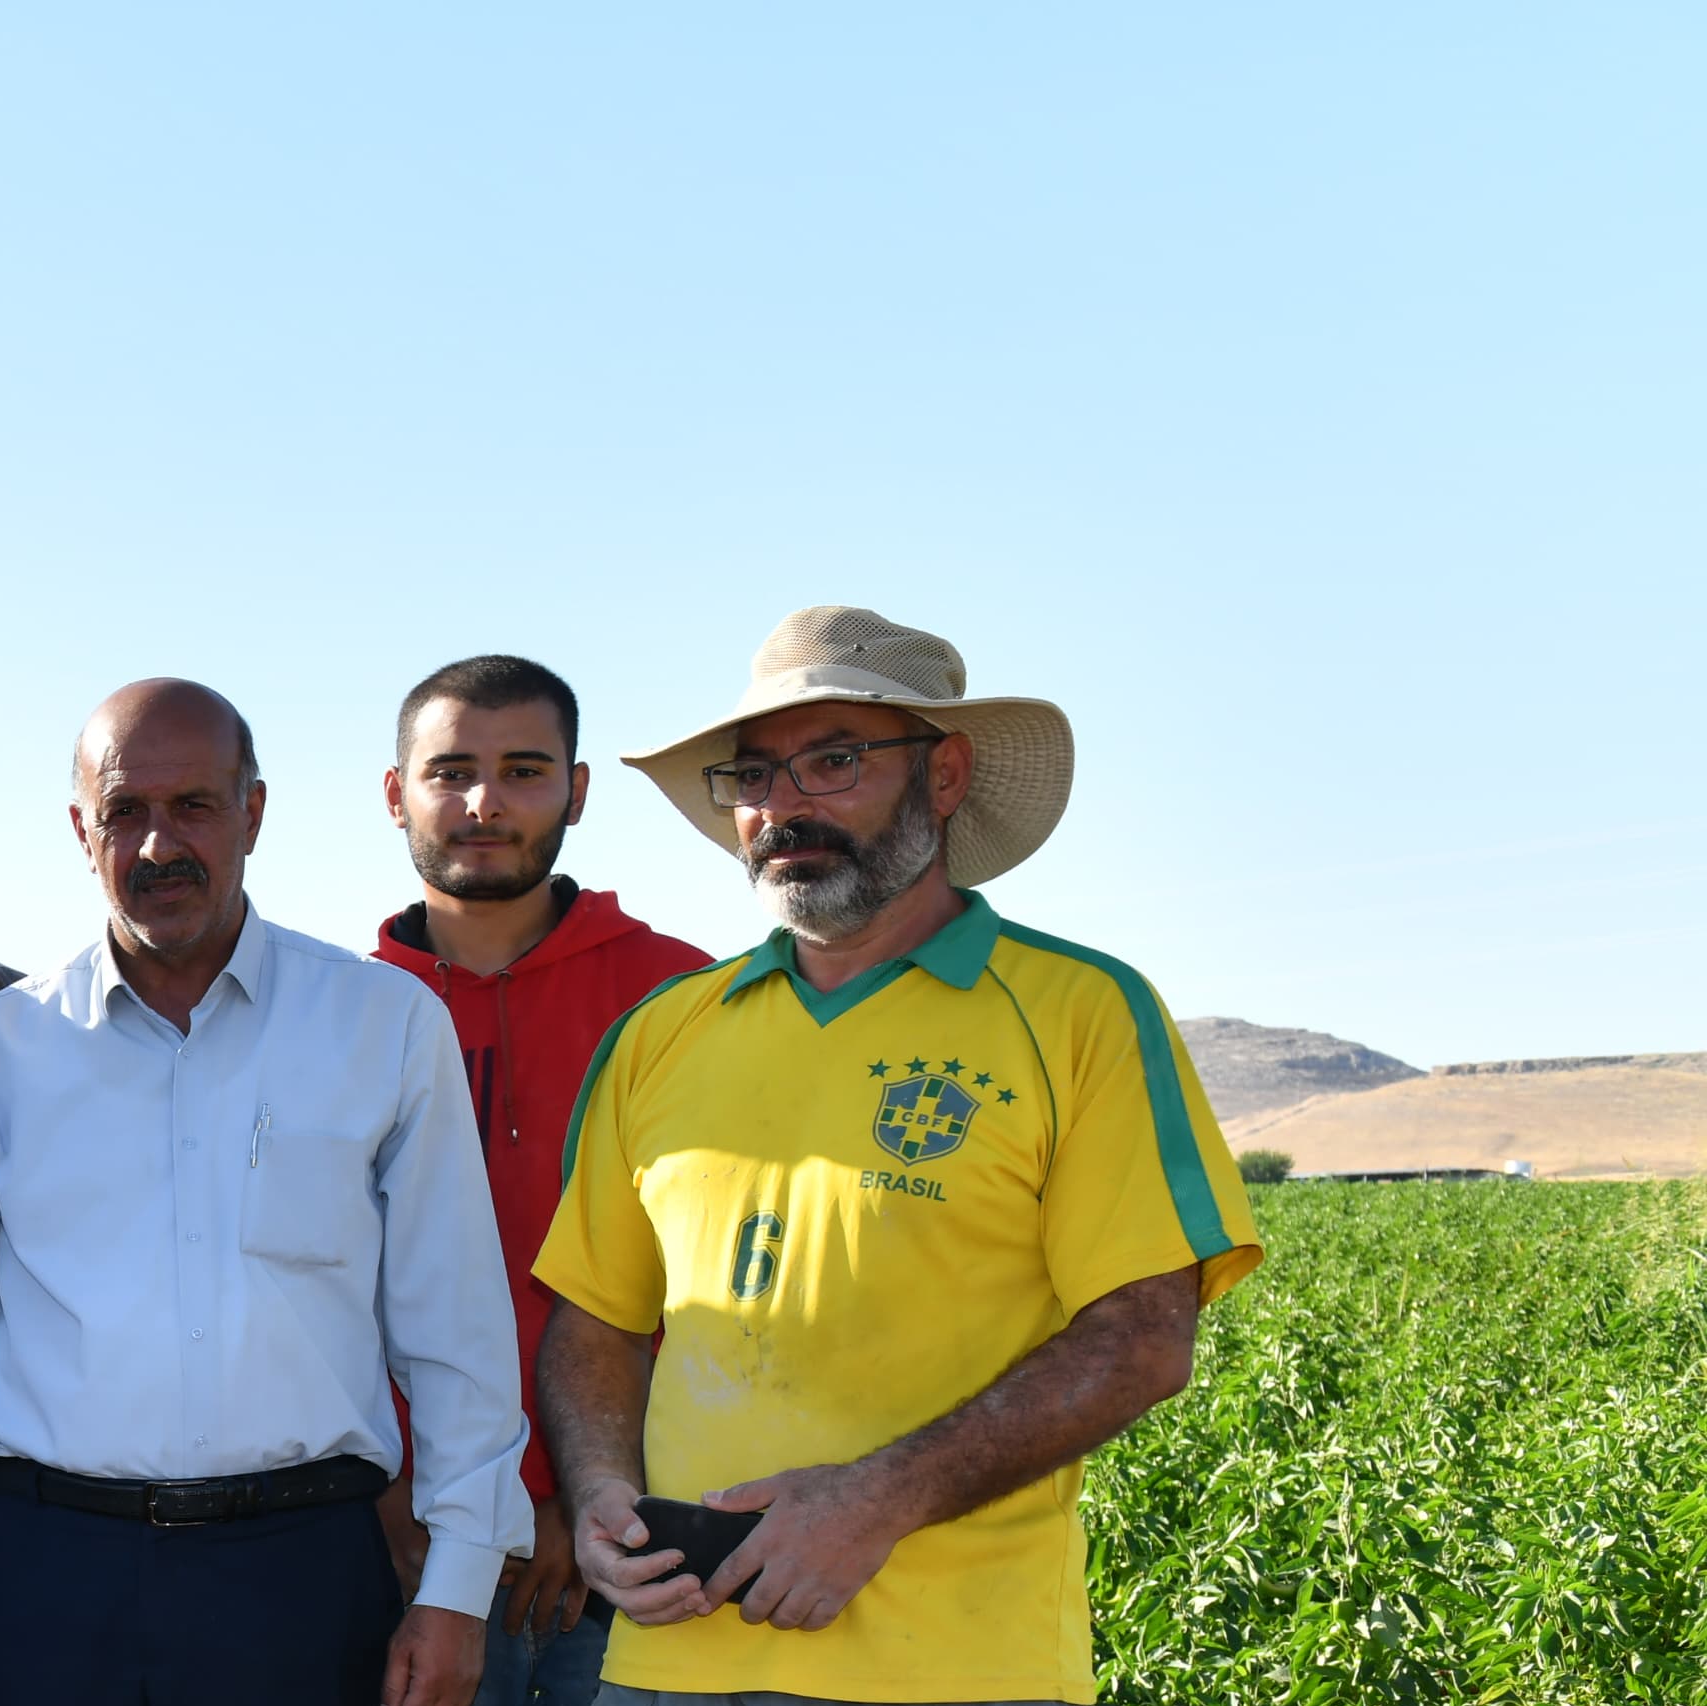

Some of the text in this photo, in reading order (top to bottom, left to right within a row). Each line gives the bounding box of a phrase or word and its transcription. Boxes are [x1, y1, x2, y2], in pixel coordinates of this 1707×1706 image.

[901, 1110, 943, 1129] CBF
[859, 1170, 948, 1202] BRASIL
[727, 1209, 786, 1302] 6
